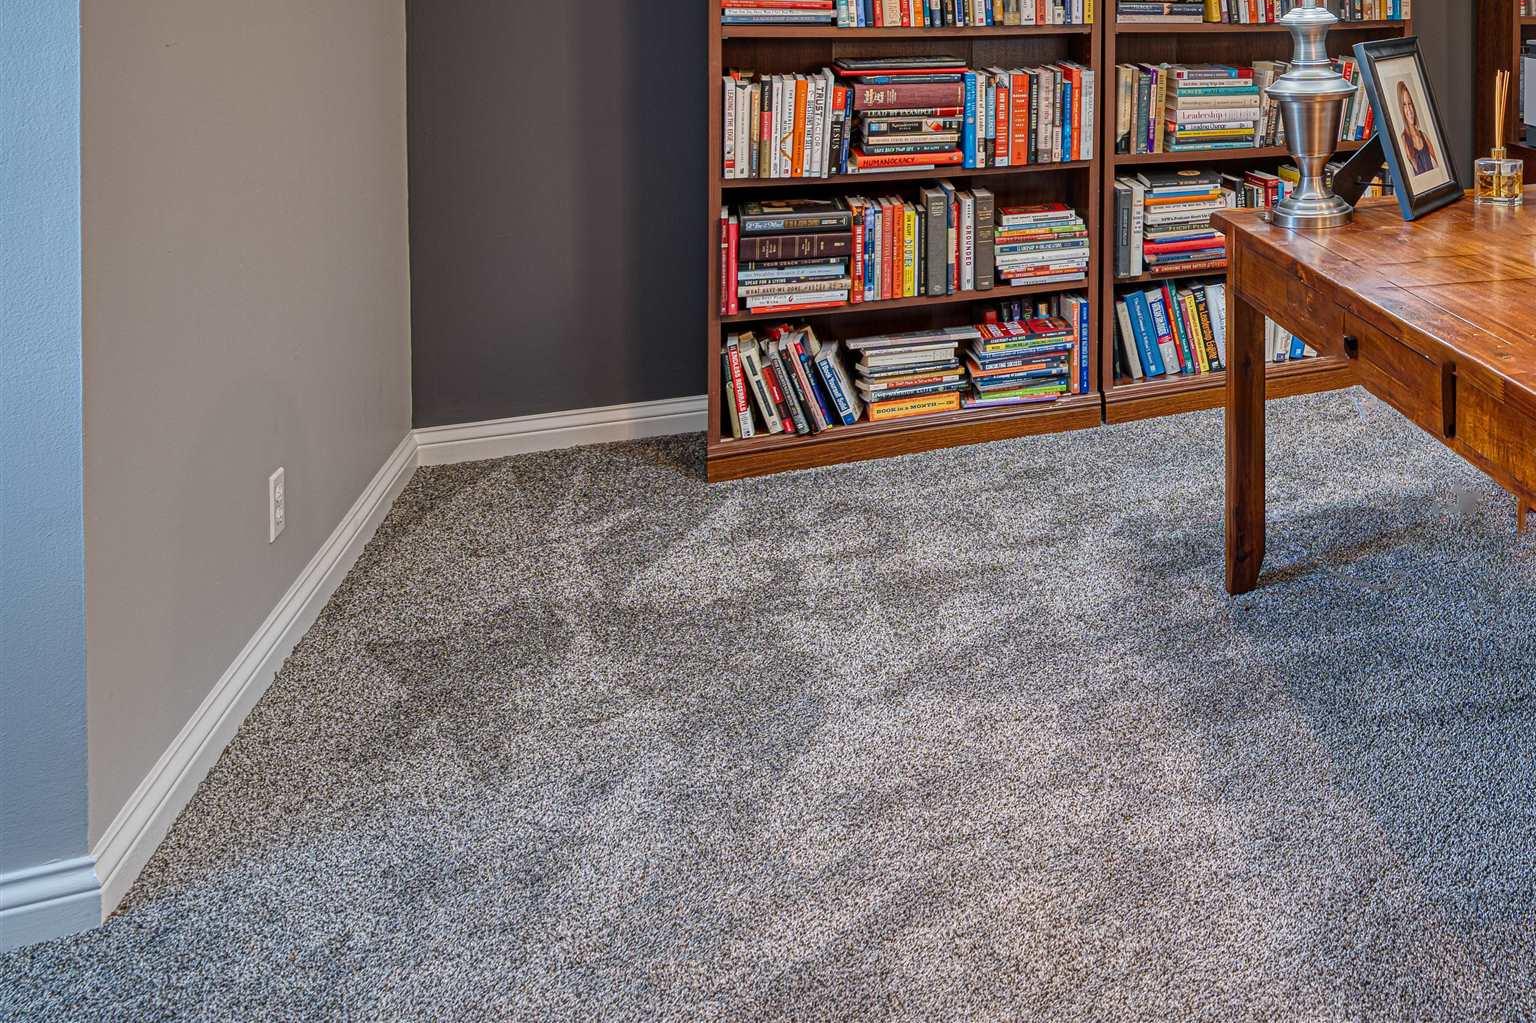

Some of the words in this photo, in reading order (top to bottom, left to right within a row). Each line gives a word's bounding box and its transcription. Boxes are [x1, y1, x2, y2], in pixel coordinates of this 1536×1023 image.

[815, 86, 824, 117] TRUST
[1182, 112, 1223, 121] Leadership
[814, 118, 822, 147] FACTOR
[832, 124, 840, 150] JESUS
[863, 157, 916, 166] HUMANOCRACY
[1200, 311, 1211, 340] Leadership
[1206, 340, 1218, 359] Engine
[732, 359, 742, 378] ENDLESS
[819, 364, 832, 378] Book
[828, 378, 842, 398] Yourself
[736, 378, 747, 412] REFERRALS
[910, 402, 937, 410] MONTH
